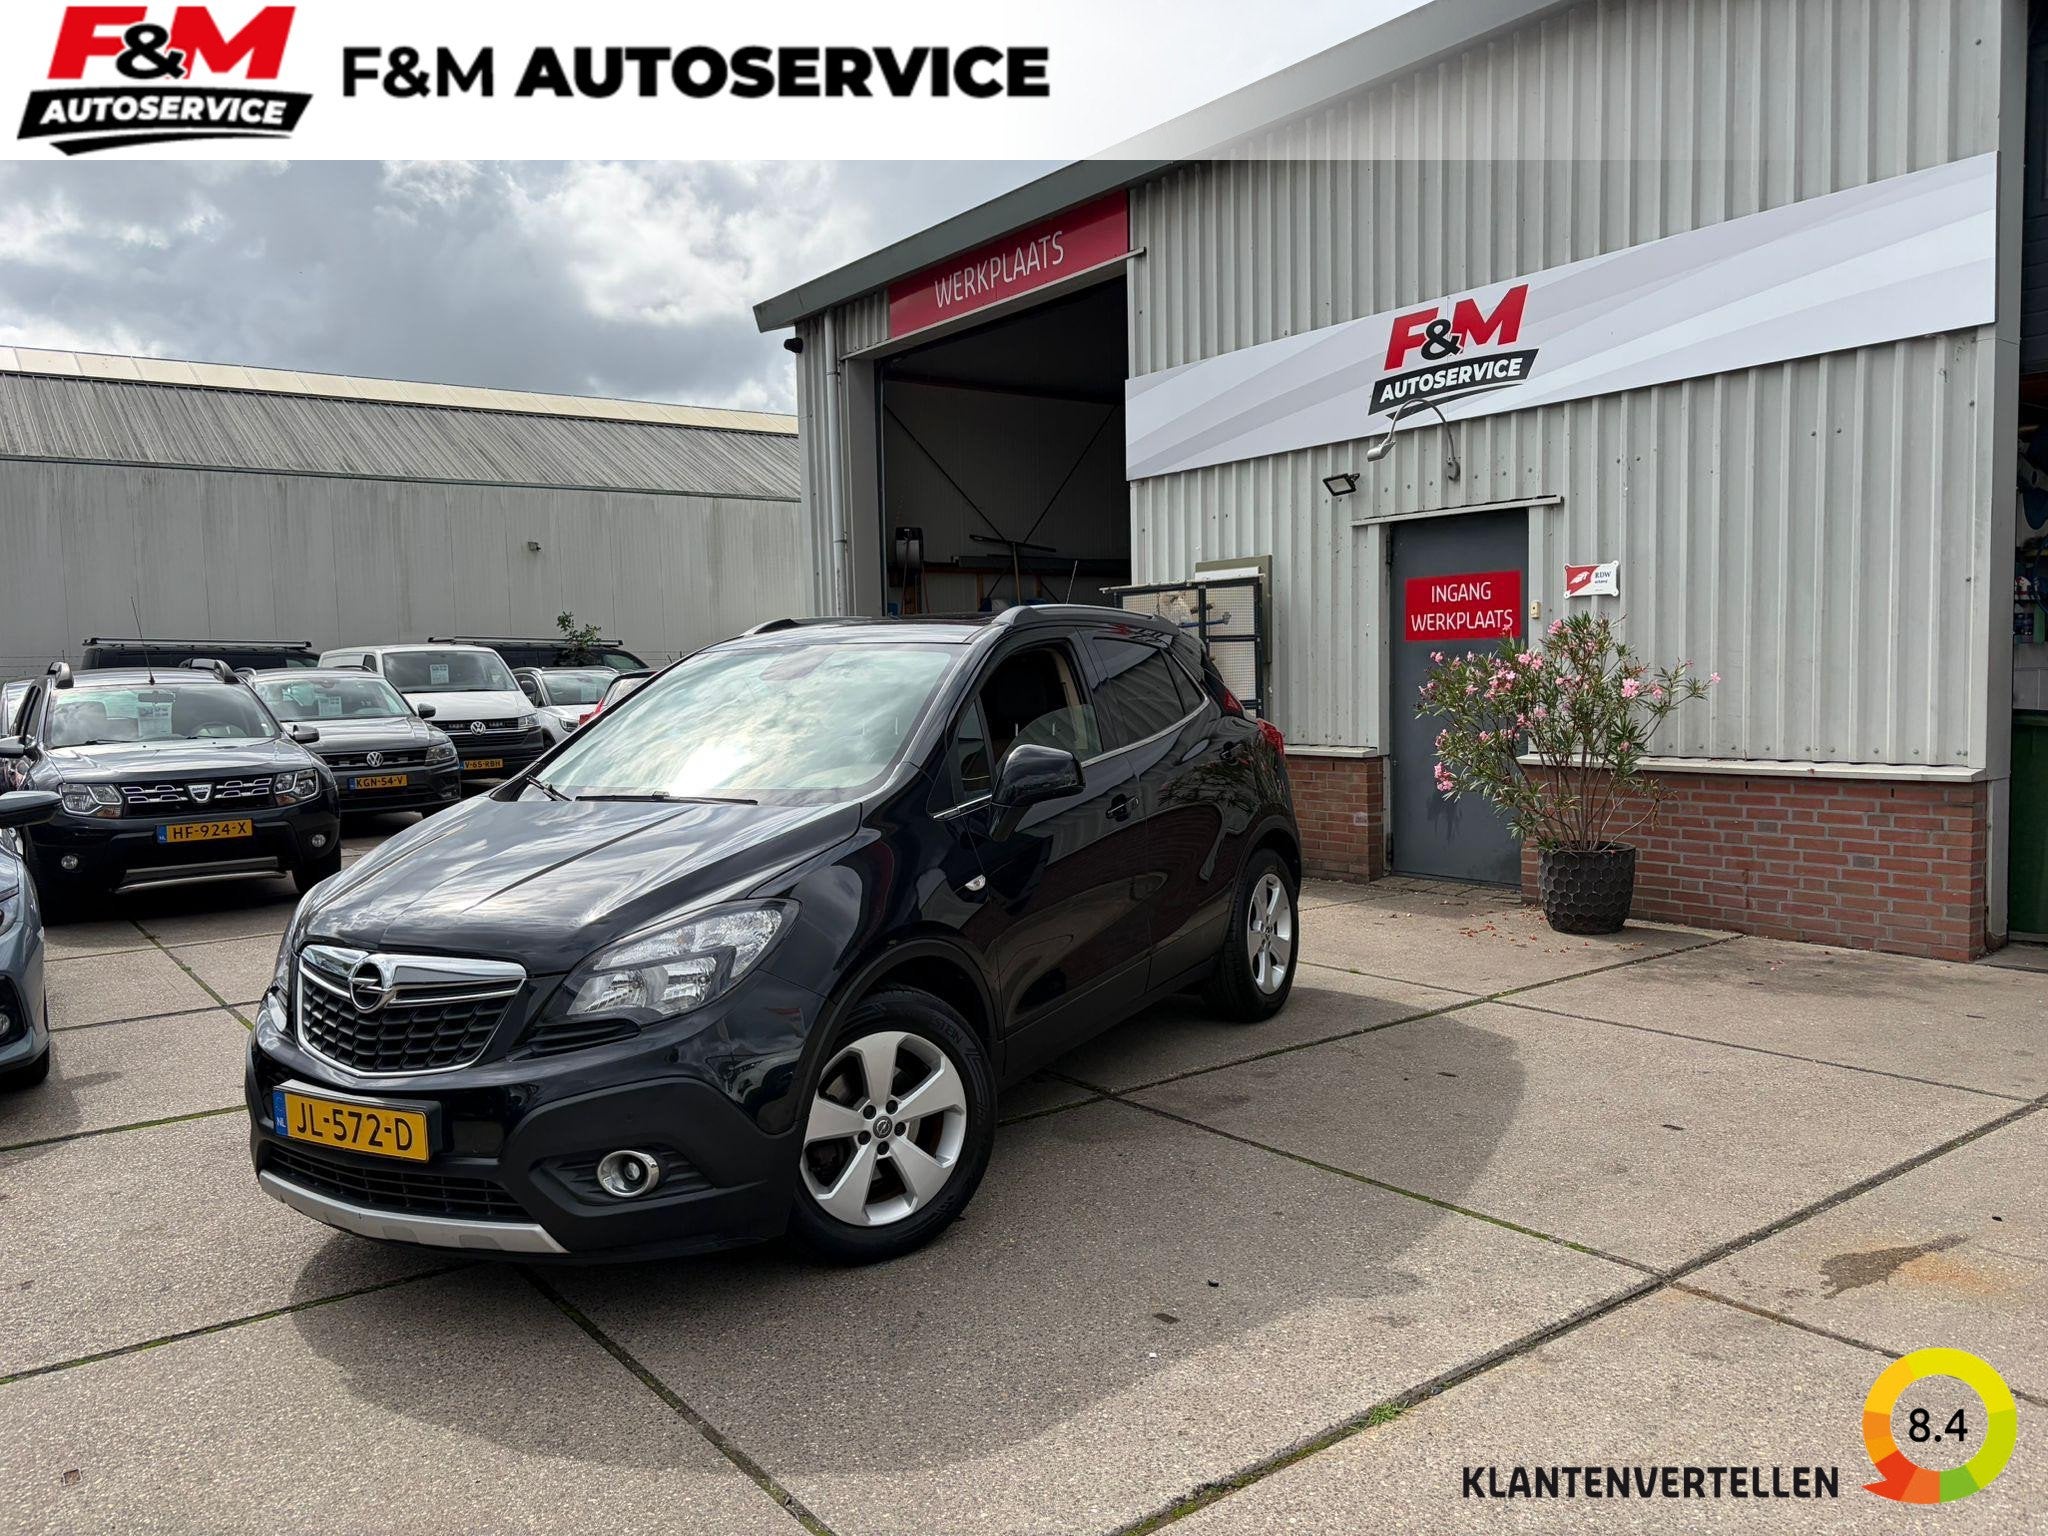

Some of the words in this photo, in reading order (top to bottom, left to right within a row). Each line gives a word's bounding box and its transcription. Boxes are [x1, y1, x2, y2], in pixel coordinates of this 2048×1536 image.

[934, 230, 1065, 309] WERKPLAATS
[1384, 283, 1529, 371] F&M
[1379, 357, 1524, 404] AUTOSERVICE
[1431, 581, 1492, 603] INGANG
[1410, 609, 1513, 632] WERKPLAATS
[356, 775, 403, 788] KGN-54-V
[173, 822, 247, 840] HF-924-X
[276, 1116, 287, 1128] NL
[296, 1102, 413, 1151] JL-572-D
